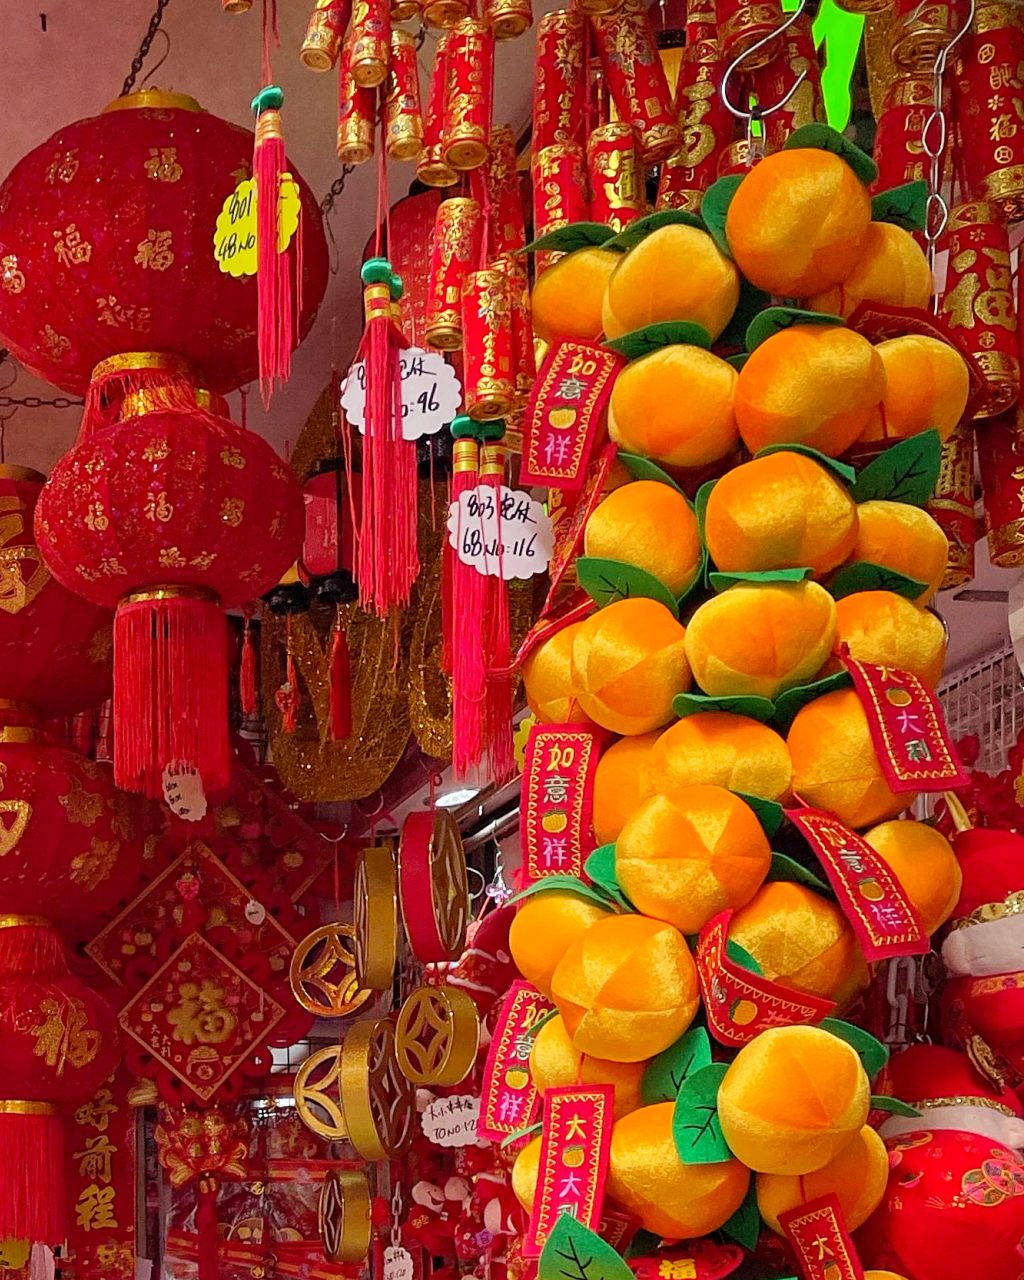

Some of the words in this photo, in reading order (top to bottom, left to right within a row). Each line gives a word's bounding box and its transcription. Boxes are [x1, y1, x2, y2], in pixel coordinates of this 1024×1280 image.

[54, 223, 92, 269] 福
[133, 228, 175, 271] 福
[143, 491, 174, 523] 福
[166, 979, 237, 1045] 福
[31, 996, 105, 1078] 福
[73, 1088, 119, 1232] 好前程
[658, 1258, 697, 1280] 福
